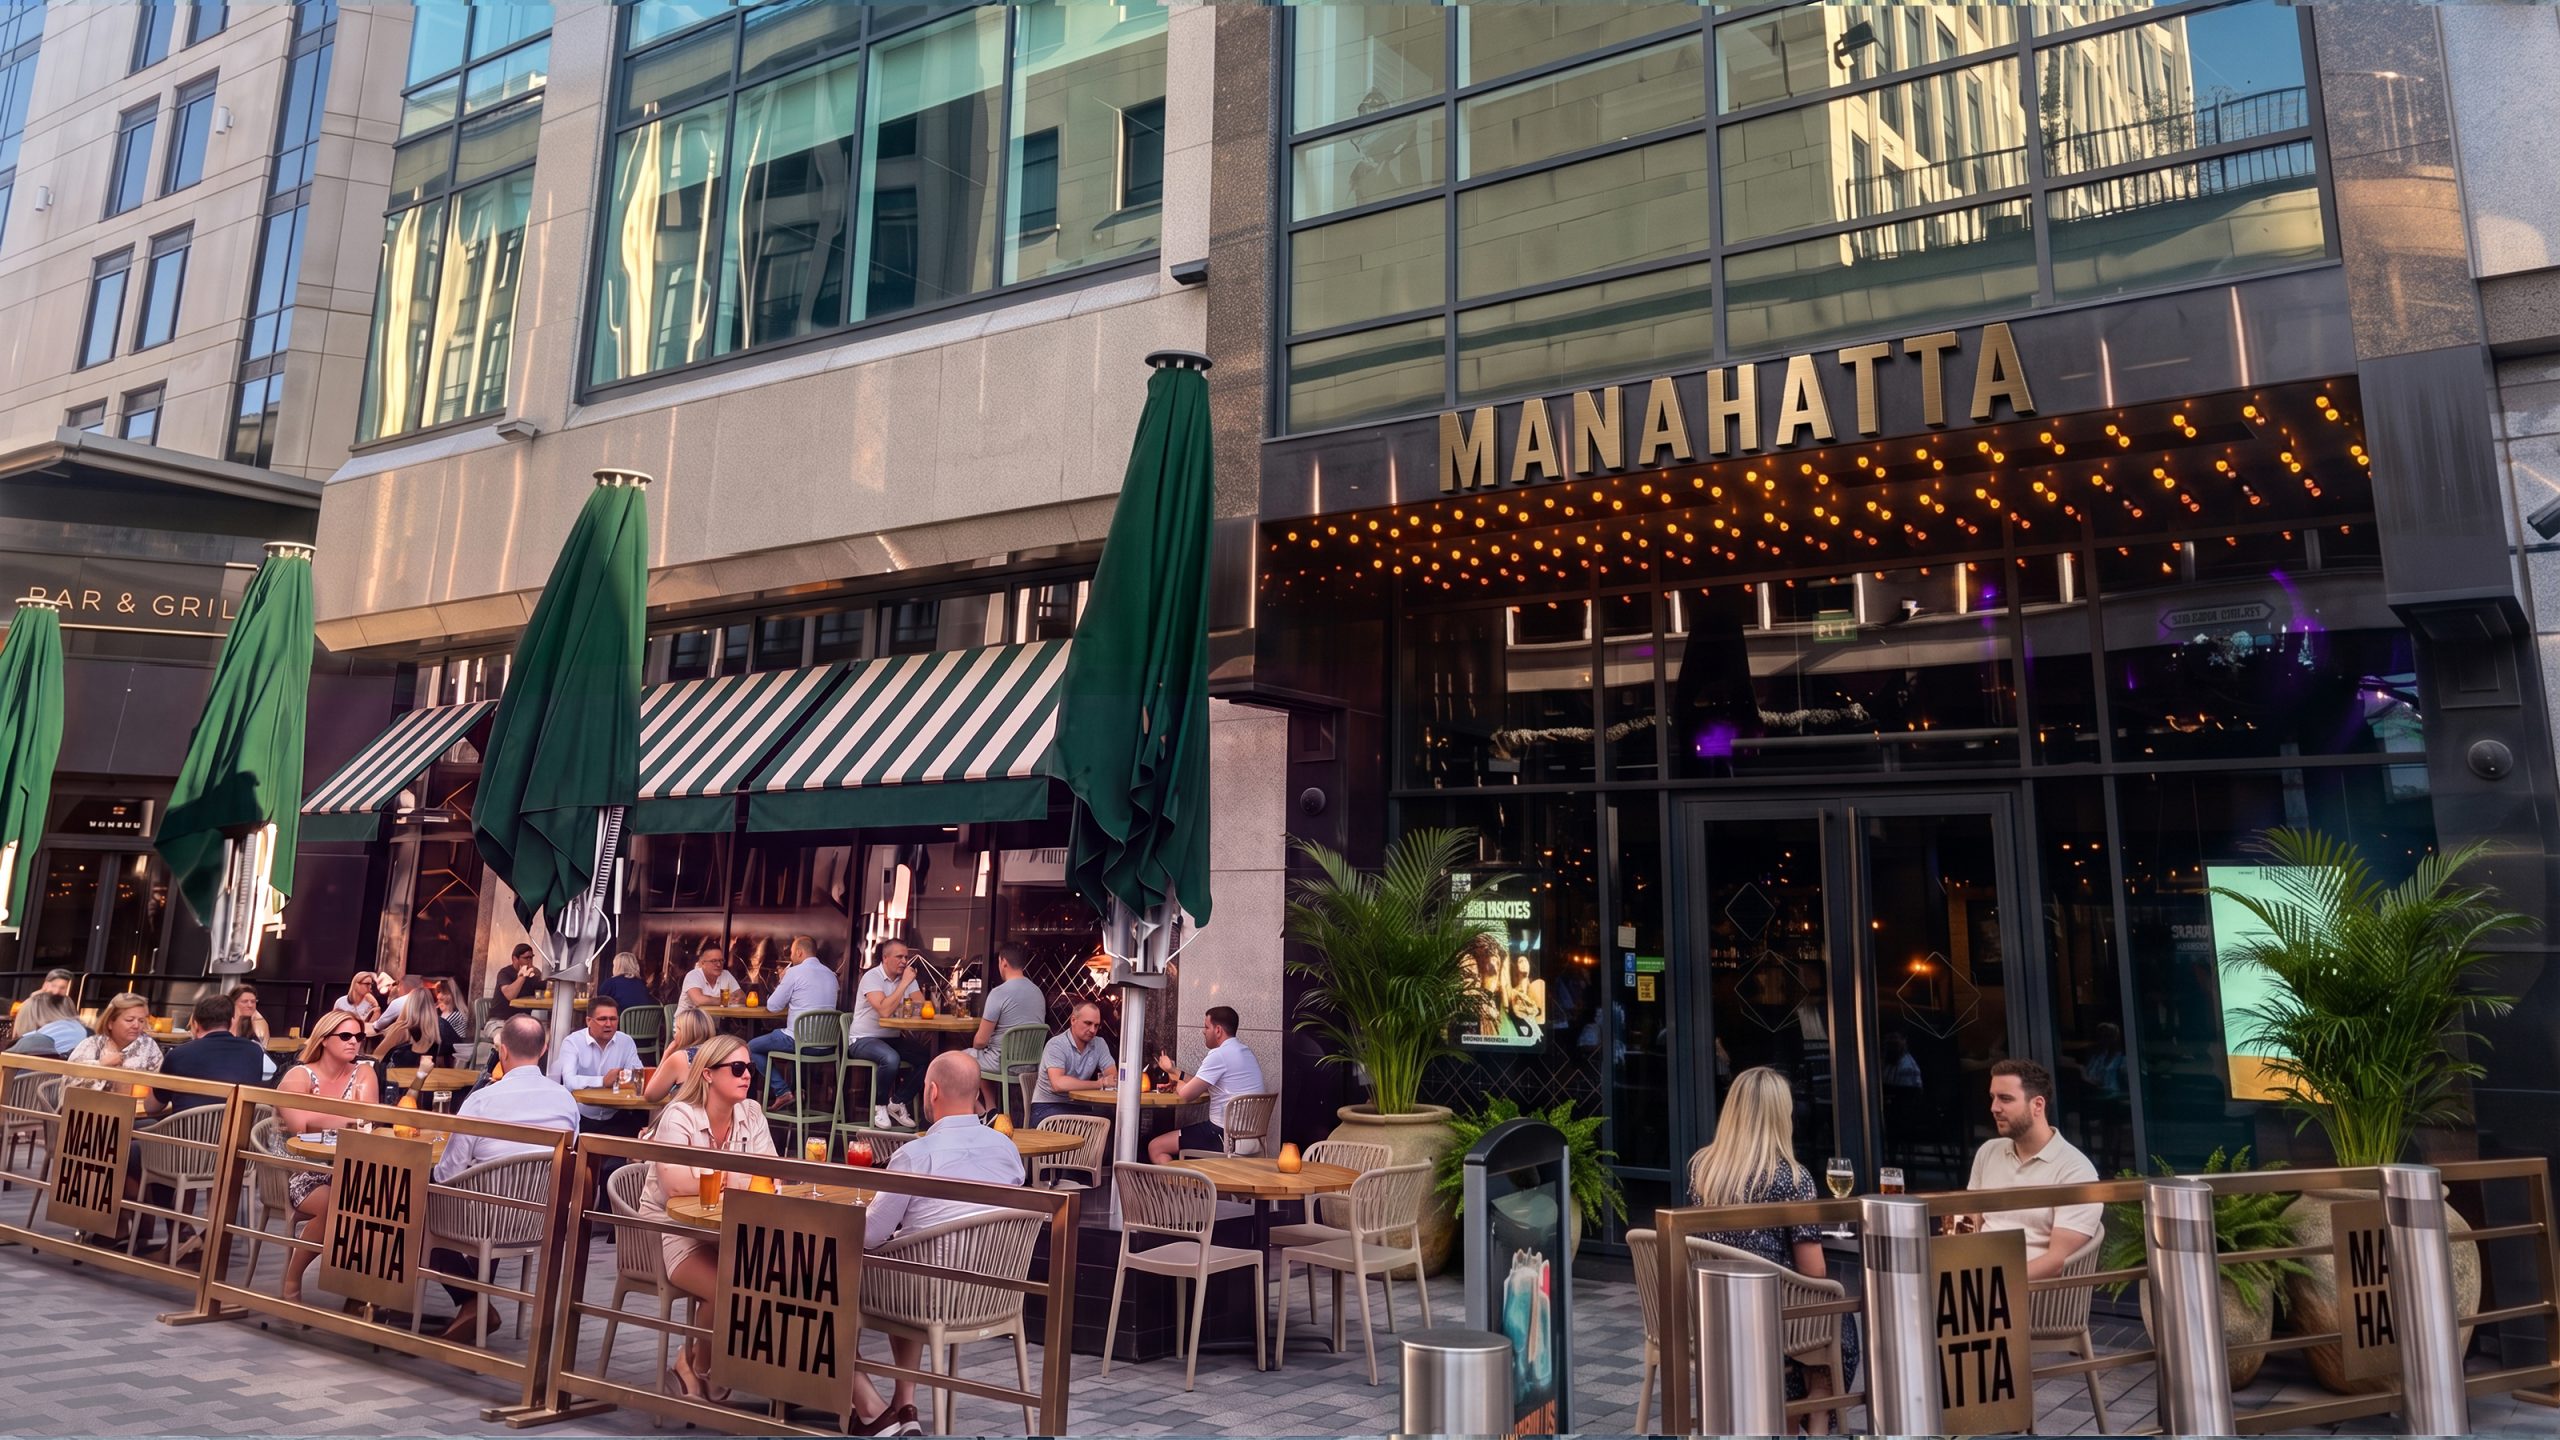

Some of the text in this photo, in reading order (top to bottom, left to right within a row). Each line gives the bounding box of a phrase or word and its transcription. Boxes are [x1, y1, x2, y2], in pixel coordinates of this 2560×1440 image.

[1438, 322, 2037, 492] MANAHATTA
[116, 592, 136, 613] &
[152, 595, 236, 620] GRIL
[63, 1109, 120, 1164] MANA
[56, 1157, 114, 1214] HATTA
[338, 1158, 411, 1224] MANA
[330, 1213, 405, 1283] HATTA
[732, 1223, 839, 1306] MANA
[2348, 1229, 2389, 1288] MA
[727, 1293, 836, 1378] HATTA
[1937, 1266, 2011, 1338] ANA
